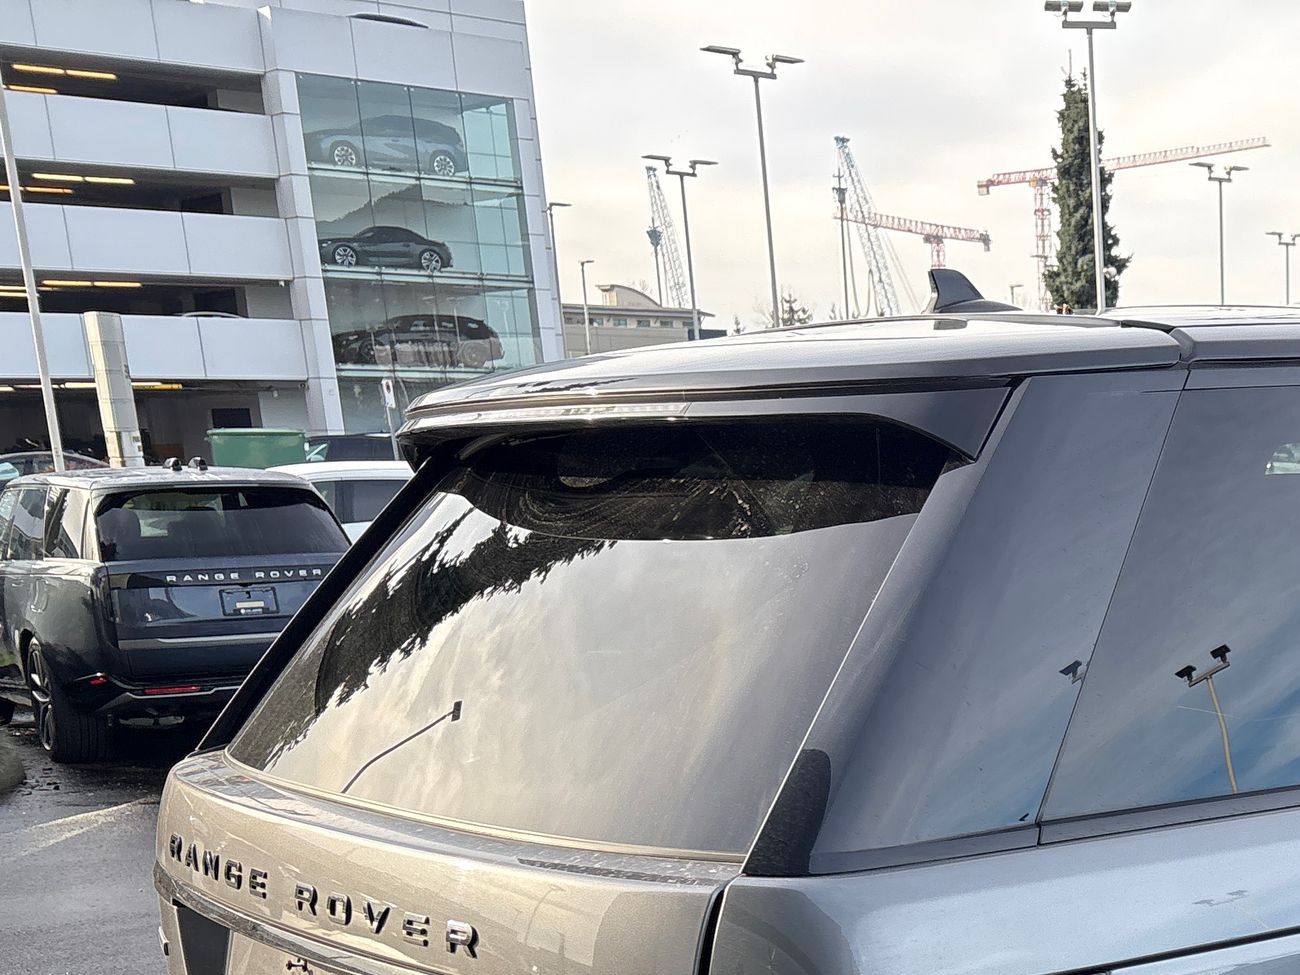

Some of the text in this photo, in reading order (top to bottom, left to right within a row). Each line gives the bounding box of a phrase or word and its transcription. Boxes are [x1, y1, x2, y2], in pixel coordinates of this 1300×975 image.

[166, 568, 322, 583] RANGE ROVER
[168, 833, 480, 960] RANGE ROVER
